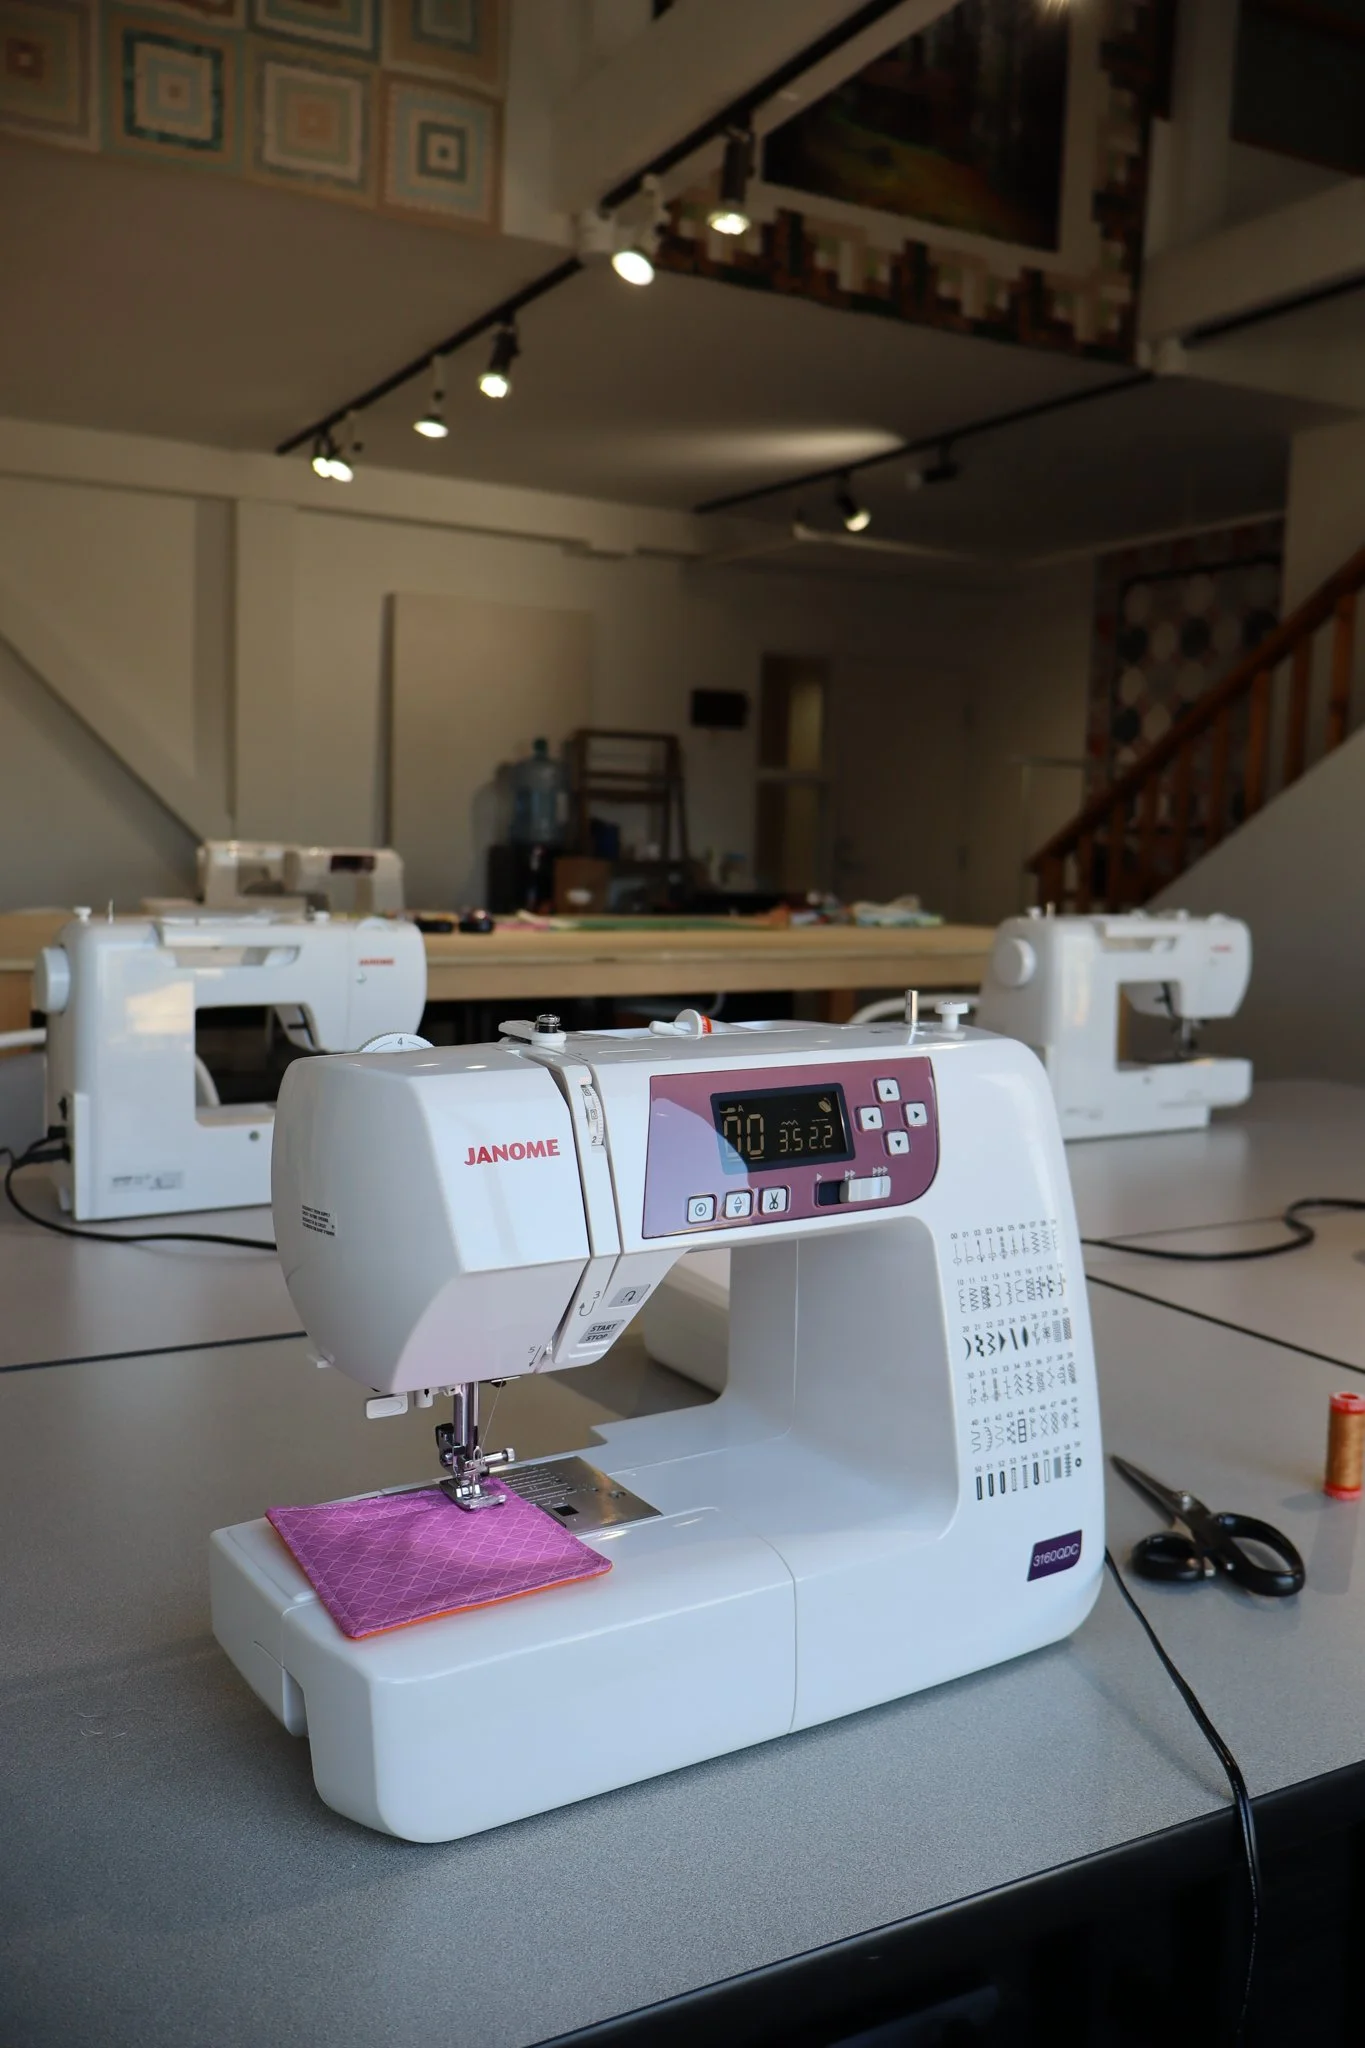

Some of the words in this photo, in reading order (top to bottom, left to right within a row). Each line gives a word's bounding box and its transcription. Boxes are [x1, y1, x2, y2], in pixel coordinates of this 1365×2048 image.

[591, 1135, 597, 1143] 2
[779, 1127, 803, 1152] 3.5
[808, 1125, 833, 1150] 2.2
[464, 1139, 561, 1166] JANOME
[593, 1290, 600, 1299] 3
[590, 1323, 617, 1333] START
[585, 1333, 608, 1342] STOP
[528, 1346, 535, 1354] 5
[1033, 1543, 1079, 1567] 3160QDC
